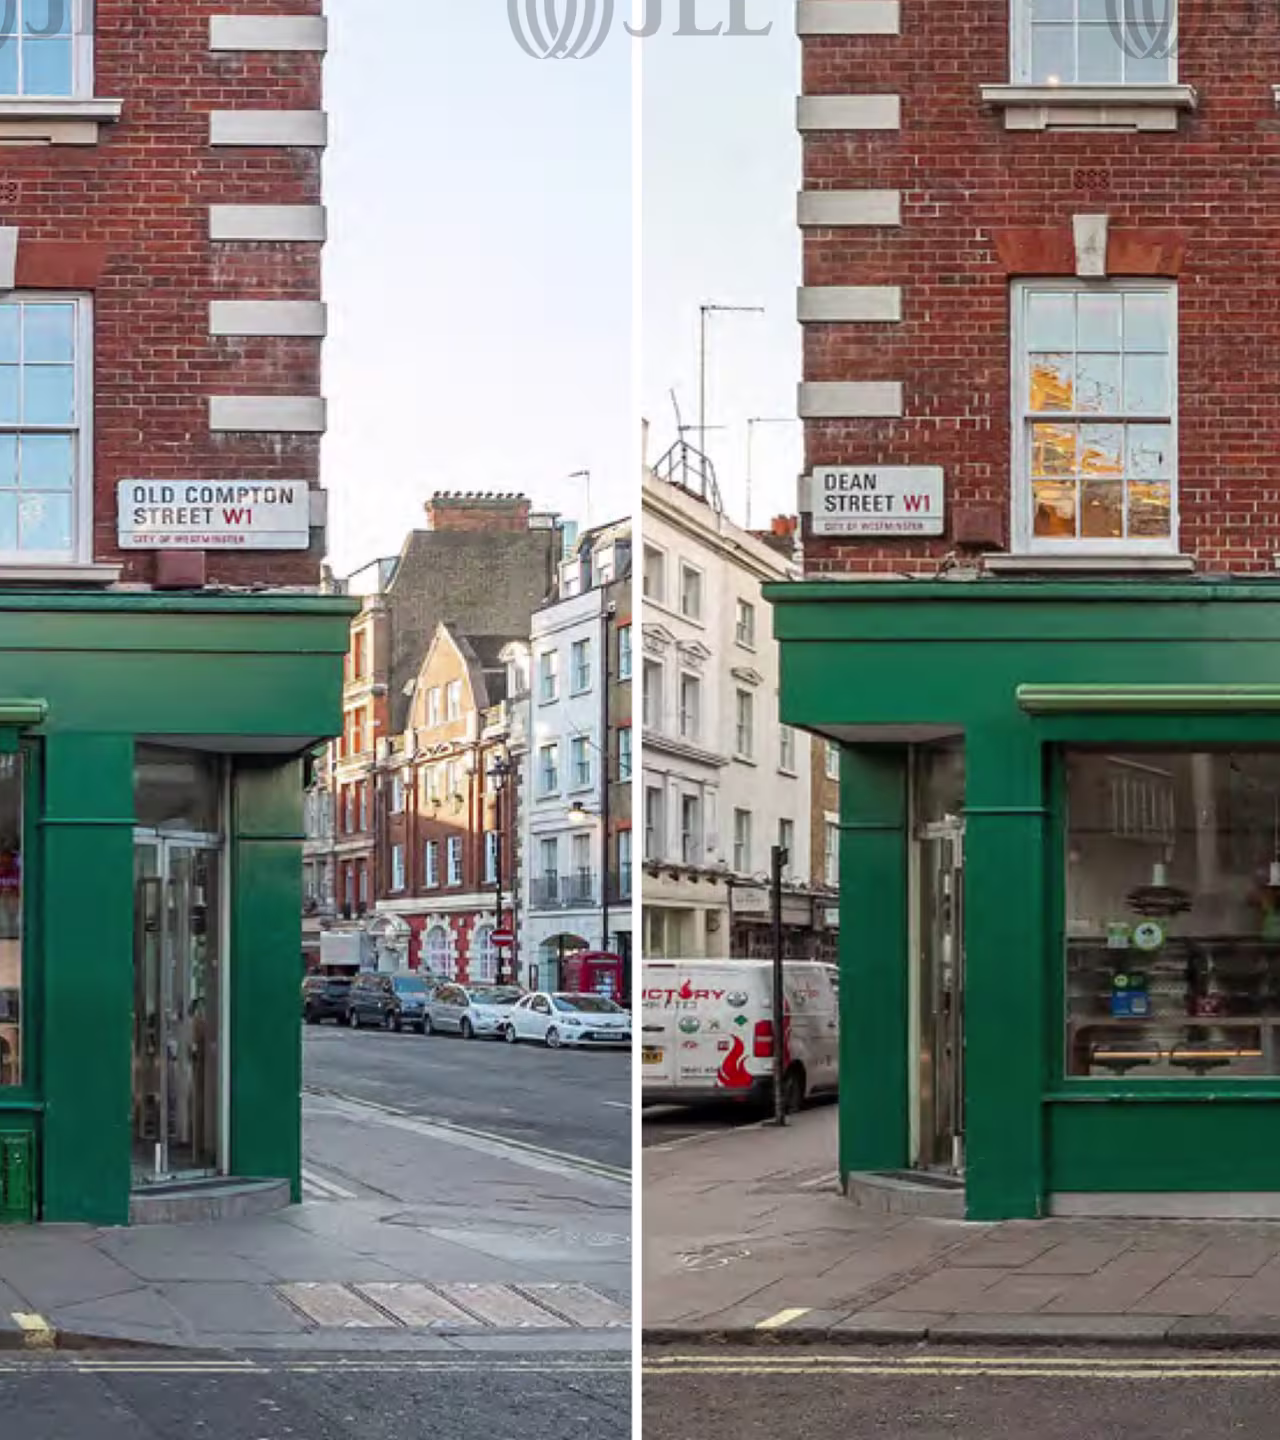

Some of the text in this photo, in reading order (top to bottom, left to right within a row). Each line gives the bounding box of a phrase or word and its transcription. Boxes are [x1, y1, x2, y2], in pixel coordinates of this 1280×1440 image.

[824, 474, 876, 490] DEAN
[133, 486, 294, 503] OLD COMPTON
[824, 495, 930, 512] STREET W1
[133, 507, 253, 524] STREET W1
